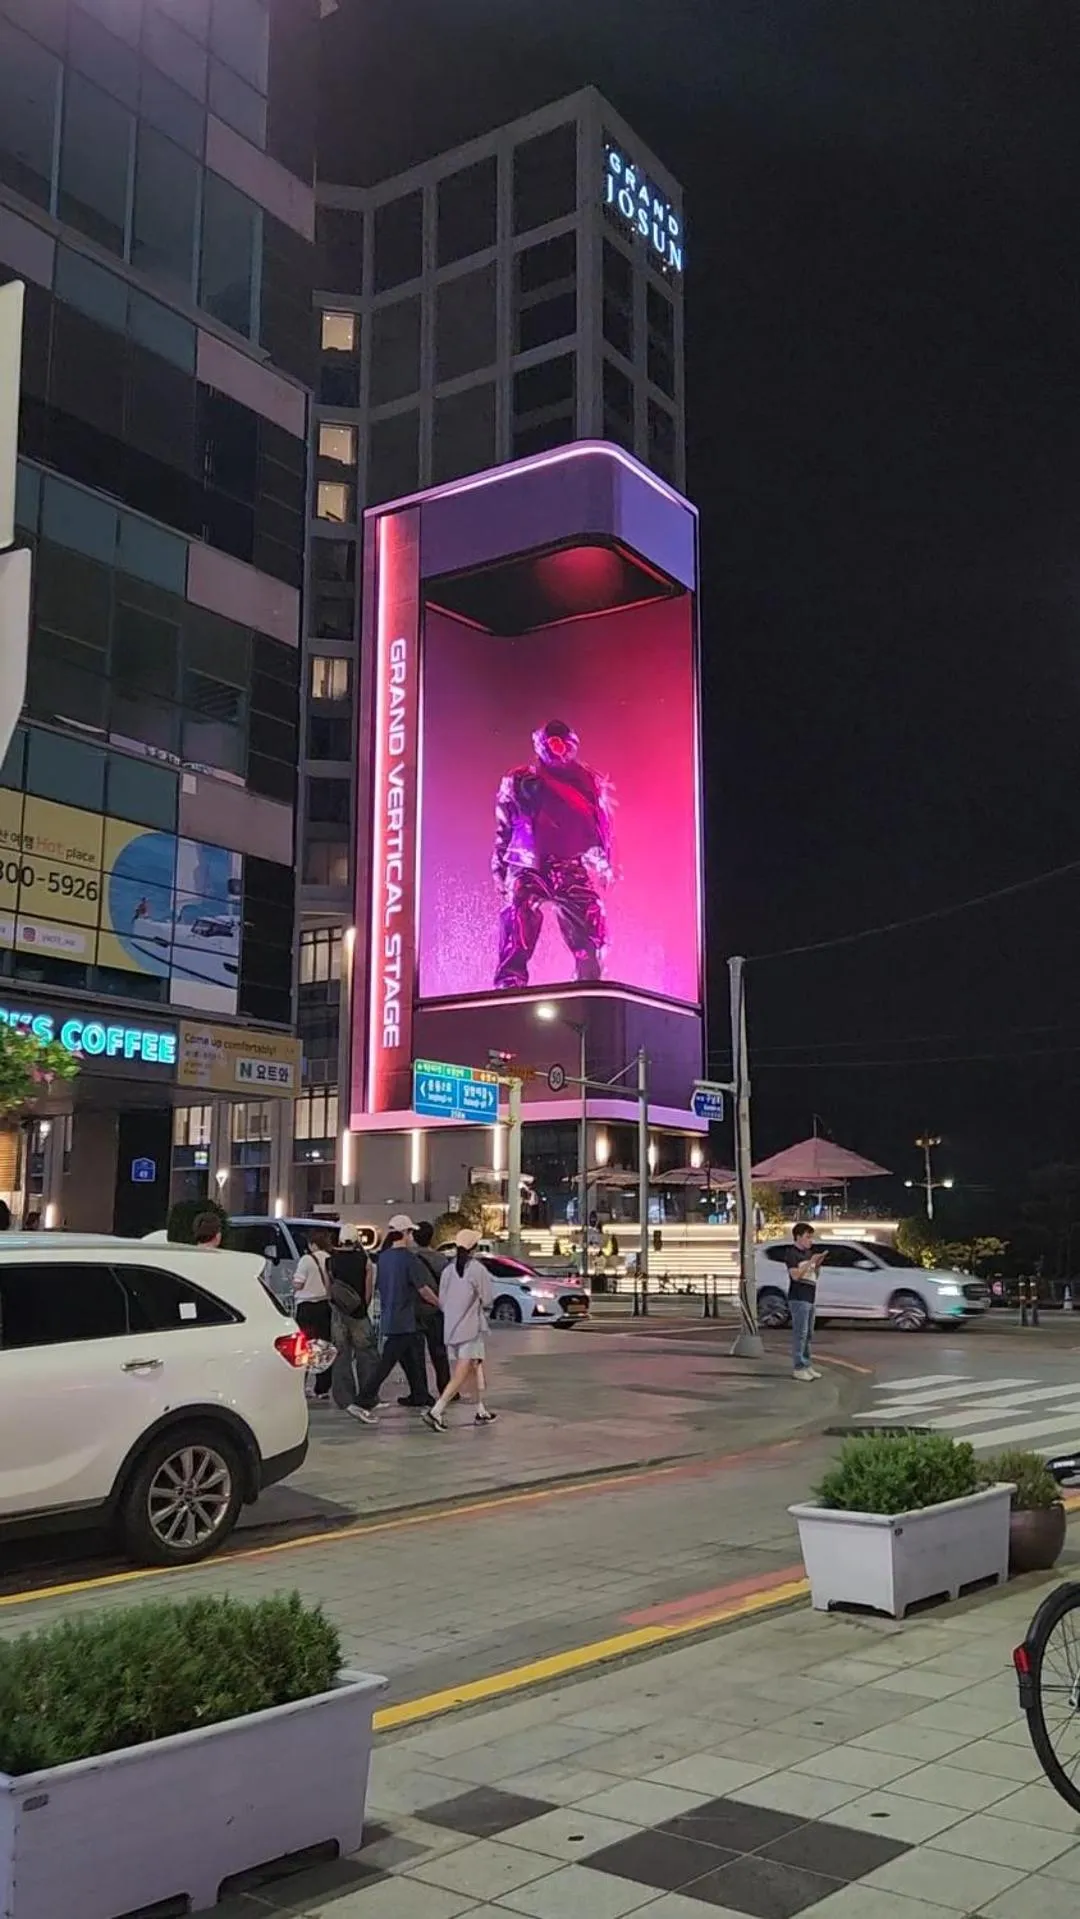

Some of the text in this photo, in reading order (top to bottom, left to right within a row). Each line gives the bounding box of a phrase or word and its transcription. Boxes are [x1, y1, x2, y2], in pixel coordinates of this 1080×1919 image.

[606, 173, 682, 272] JOSUN
[609, 152, 679, 236] GRAND
[383, 637, 407, 1049] GRAND VERTICAL STAGE
[61, 1019, 176, 1064] COFFEE
[184, 1032, 210, 1045] Come
